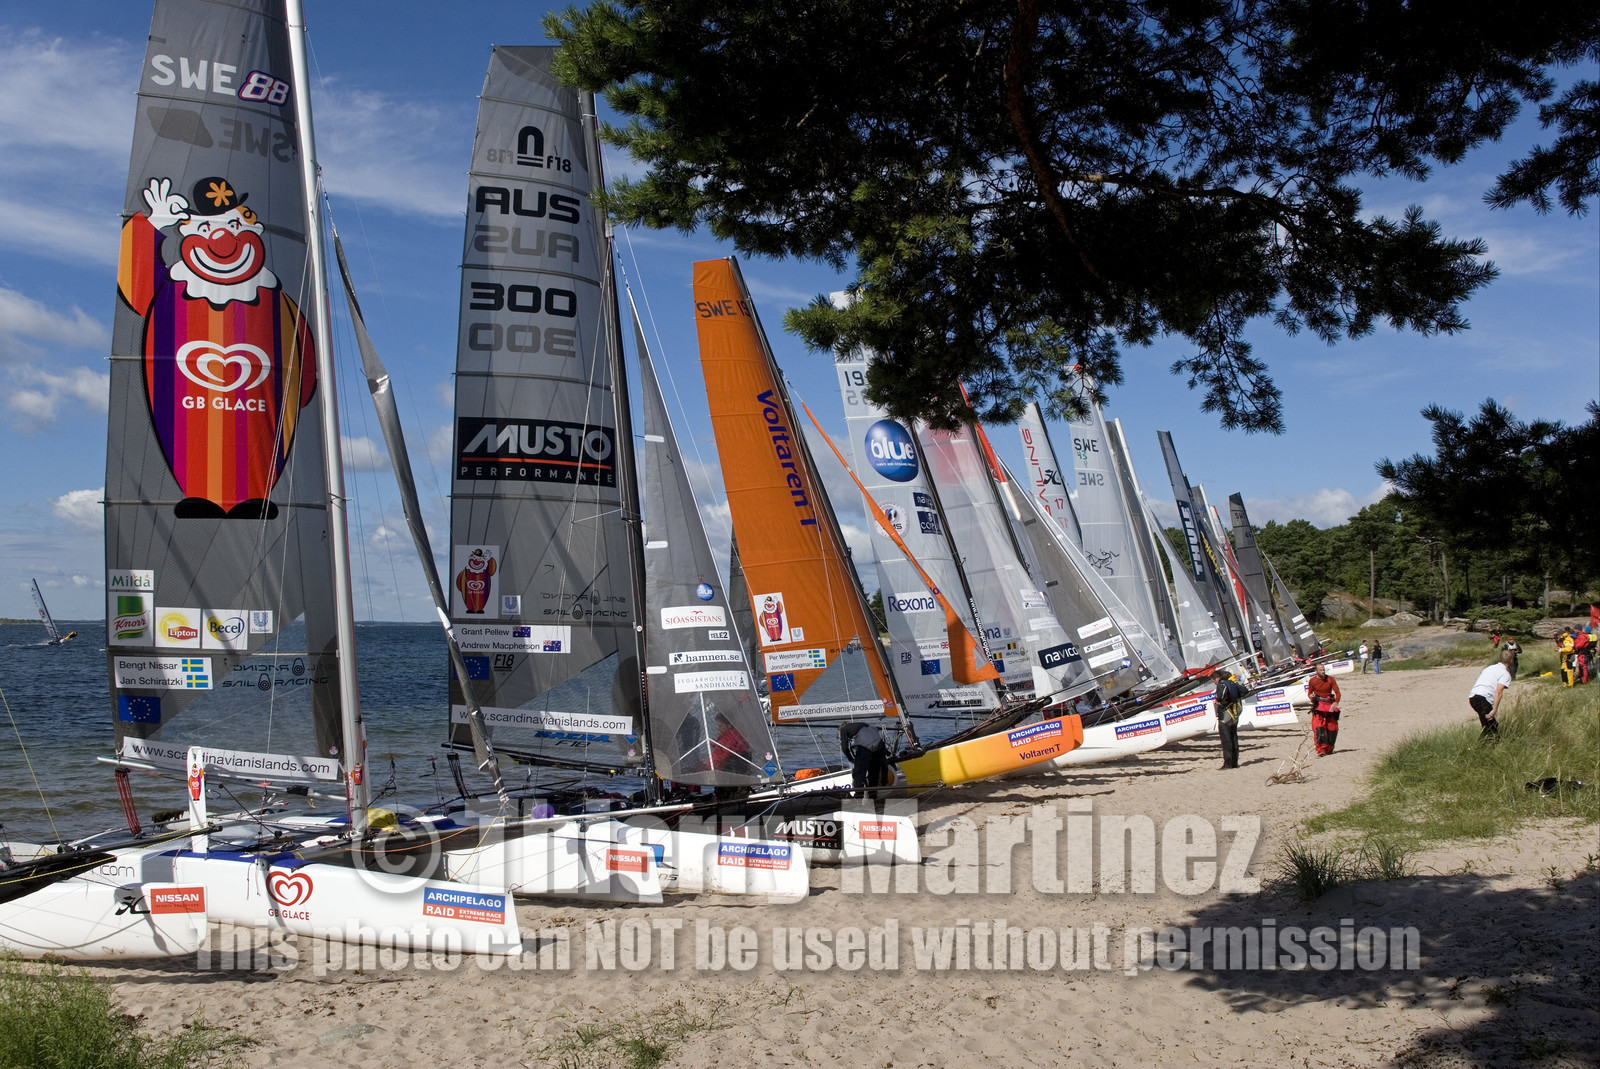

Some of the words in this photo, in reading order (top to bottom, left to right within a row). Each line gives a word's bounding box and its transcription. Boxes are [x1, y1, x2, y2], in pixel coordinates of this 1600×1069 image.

[150, 54, 237, 96] SWE
[238, 70, 291, 107] 88
[475, 185, 580, 225] AUS
[469, 281, 577, 318] 300
[697, 299, 737, 318] SWE
[182, 396, 205, 410] GB
[212, 396, 266, 412] GLACE
[462, 423, 611, 461] MUSTO
[756, 389, 809, 507] Voltaren
[870, 436, 915, 460] blue
[1073, 437, 1100, 453] SWE
[461, 466, 613, 483] PERFORMANCE
[1054, 498, 1064, 510] 17
[887, 596, 935, 613] Rexona
[543, 608, 571, 616] SAIL
[585, 609, 628, 617] RACING
[113, 617, 147, 630] Knorr
[209, 617, 241, 634] Becel
[169, 628, 197, 638] Lipton
[461, 627, 482, 636] Grant
[485, 627, 510, 636] Pellew
[710, 631, 728, 639] TELE2
[460, 641, 490, 650] Andrew
[492, 642, 540, 651] Macpherson
[493, 654, 515, 667] F18
[685, 653, 740, 663] hamnen.se
[779, 652, 808, 661] Westergren
[1044, 646, 1079, 664] navico
[119, 661, 146, 671] Bengt
[148, 661, 178, 670] Nissar
[791, 661, 813, 670] Singman
[119, 676, 136, 686] Jan
[138, 676, 183, 686] Schiratzki
[222, 680, 256, 688] SAIL
[274, 676, 329, 687] RACING
[695, 681, 738, 690] SANDHAMN
[1165, 705, 1203, 720] ARCHIPELAGO
[1117, 720, 1159, 733] ARCHIPELAGO
[1166, 717, 1182, 726] RAID
[1010, 722, 1061, 740] ARCHIPELAGO
[1117, 731, 1135, 740] RAID
[1011, 737, 1032, 748] RAID
[1019, 746, 1055, 761] Voltaren
[1054, 743, 1061, 752] T
[774, 820, 837, 837] MUSTO
[720, 844, 788, 857] ARCHIPELAGO
[719, 856, 746, 866] RAID
[155, 893, 199, 903] NISSAN
[427, 891, 502, 908] ARCHIPELAGO
[268, 908, 280, 918] GB
[281, 909, 310, 921] GLACE
[426, 905, 455, 917] RAID
[459, 908, 485, 917] EXTREME
[485, 911, 502, 919] RACE
